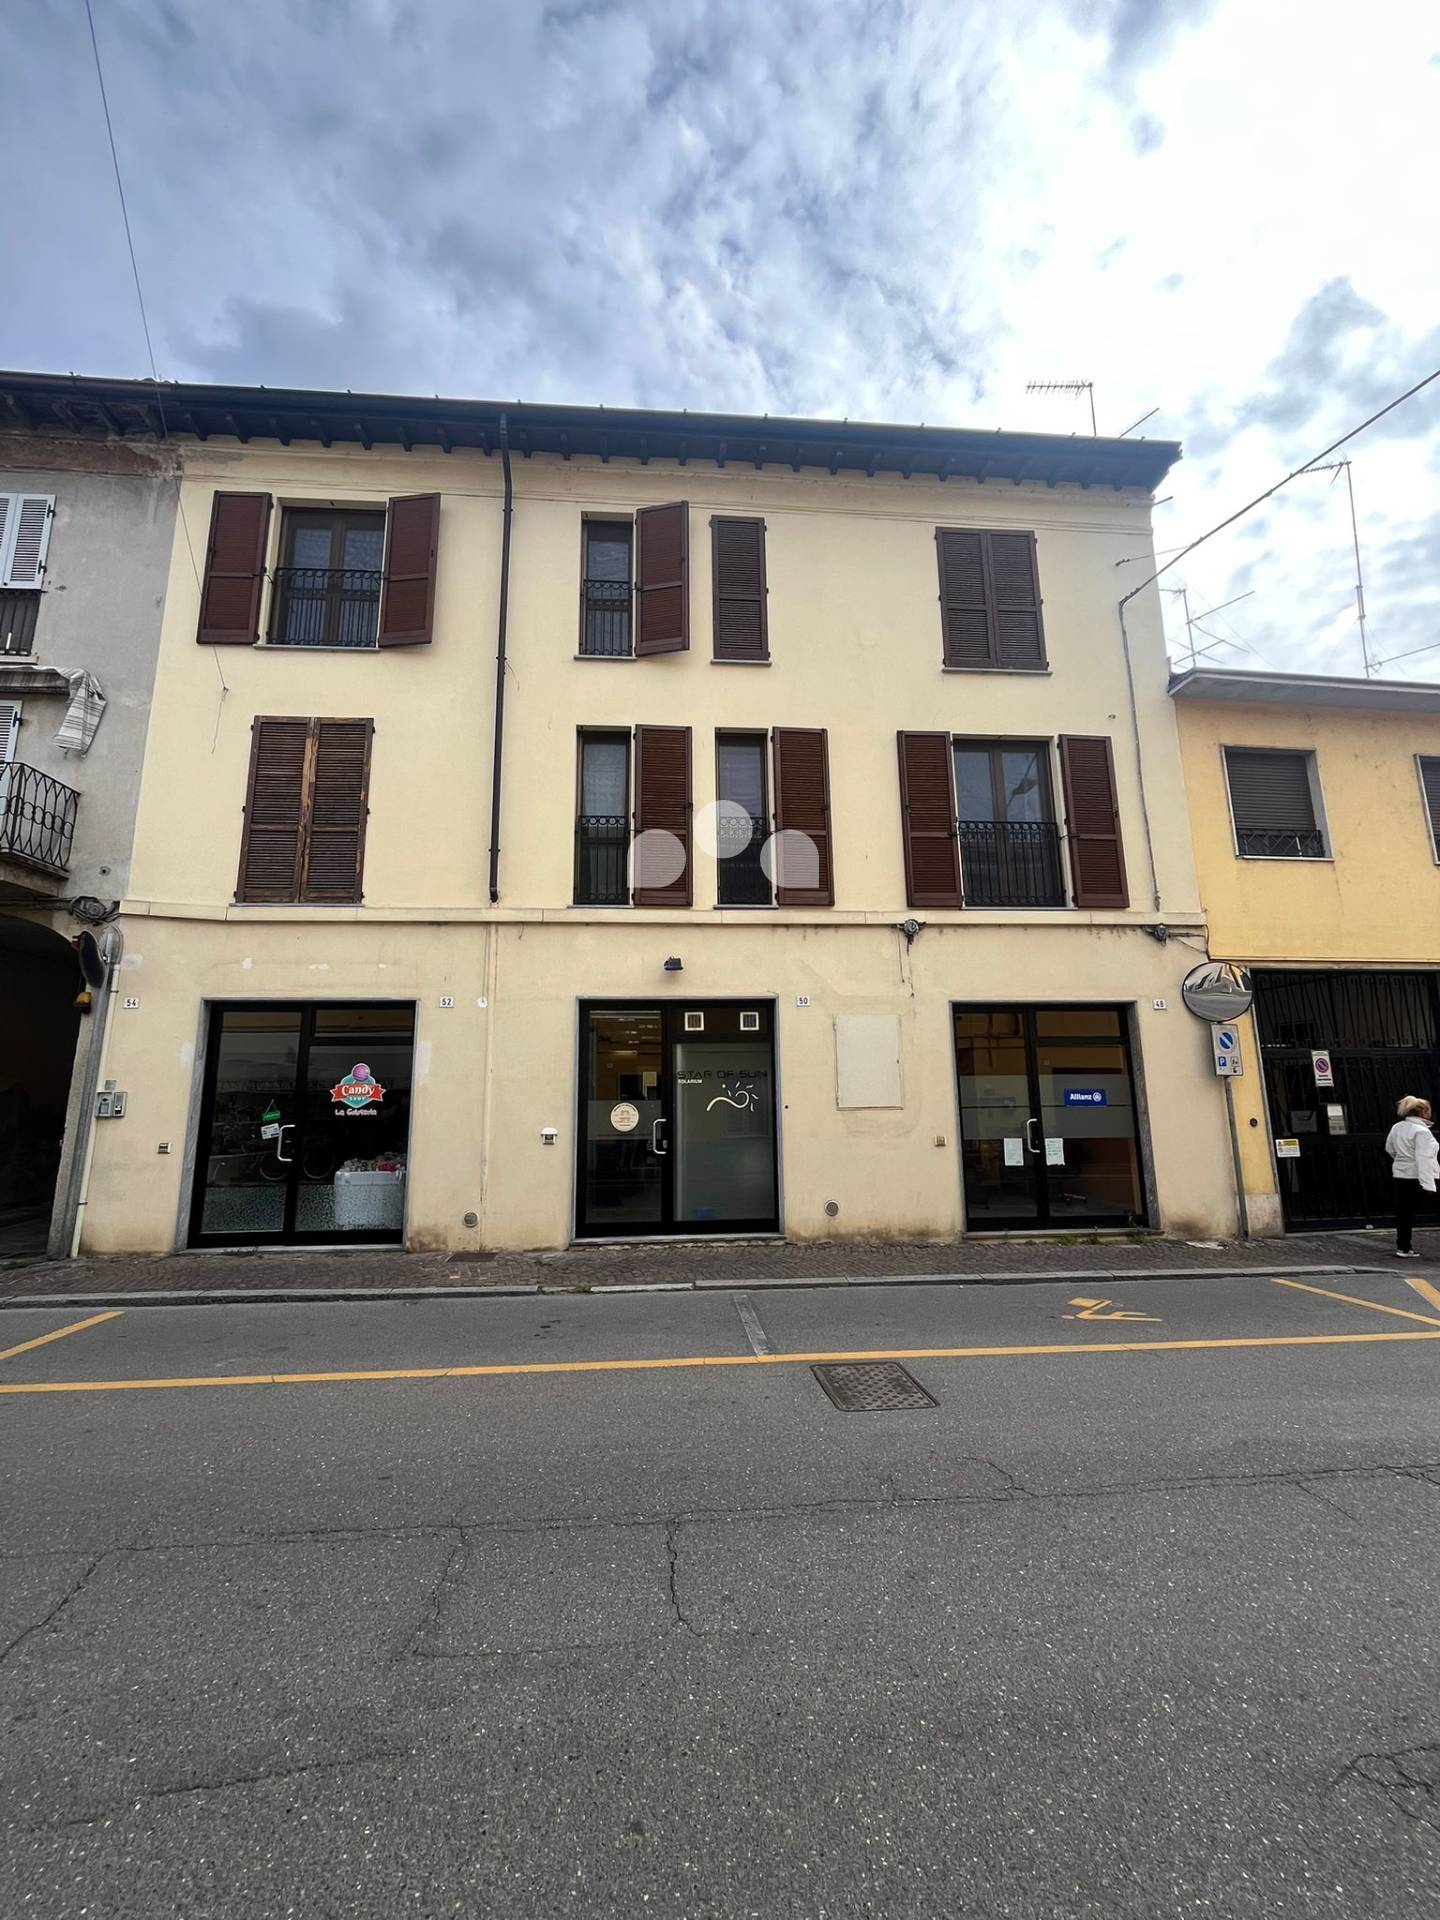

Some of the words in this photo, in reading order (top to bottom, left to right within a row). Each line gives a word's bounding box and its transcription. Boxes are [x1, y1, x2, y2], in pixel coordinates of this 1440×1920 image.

[126, 998, 137, 1007] 54
[441, 997, 452, 1006] 52
[798, 997, 809, 1005] 50
[677, 1070, 711, 1079] STAR
[717, 1070, 734, 1079] OF
[738, 1070, 767, 1078] SUN
[341, 1084, 375, 1097] Candy
